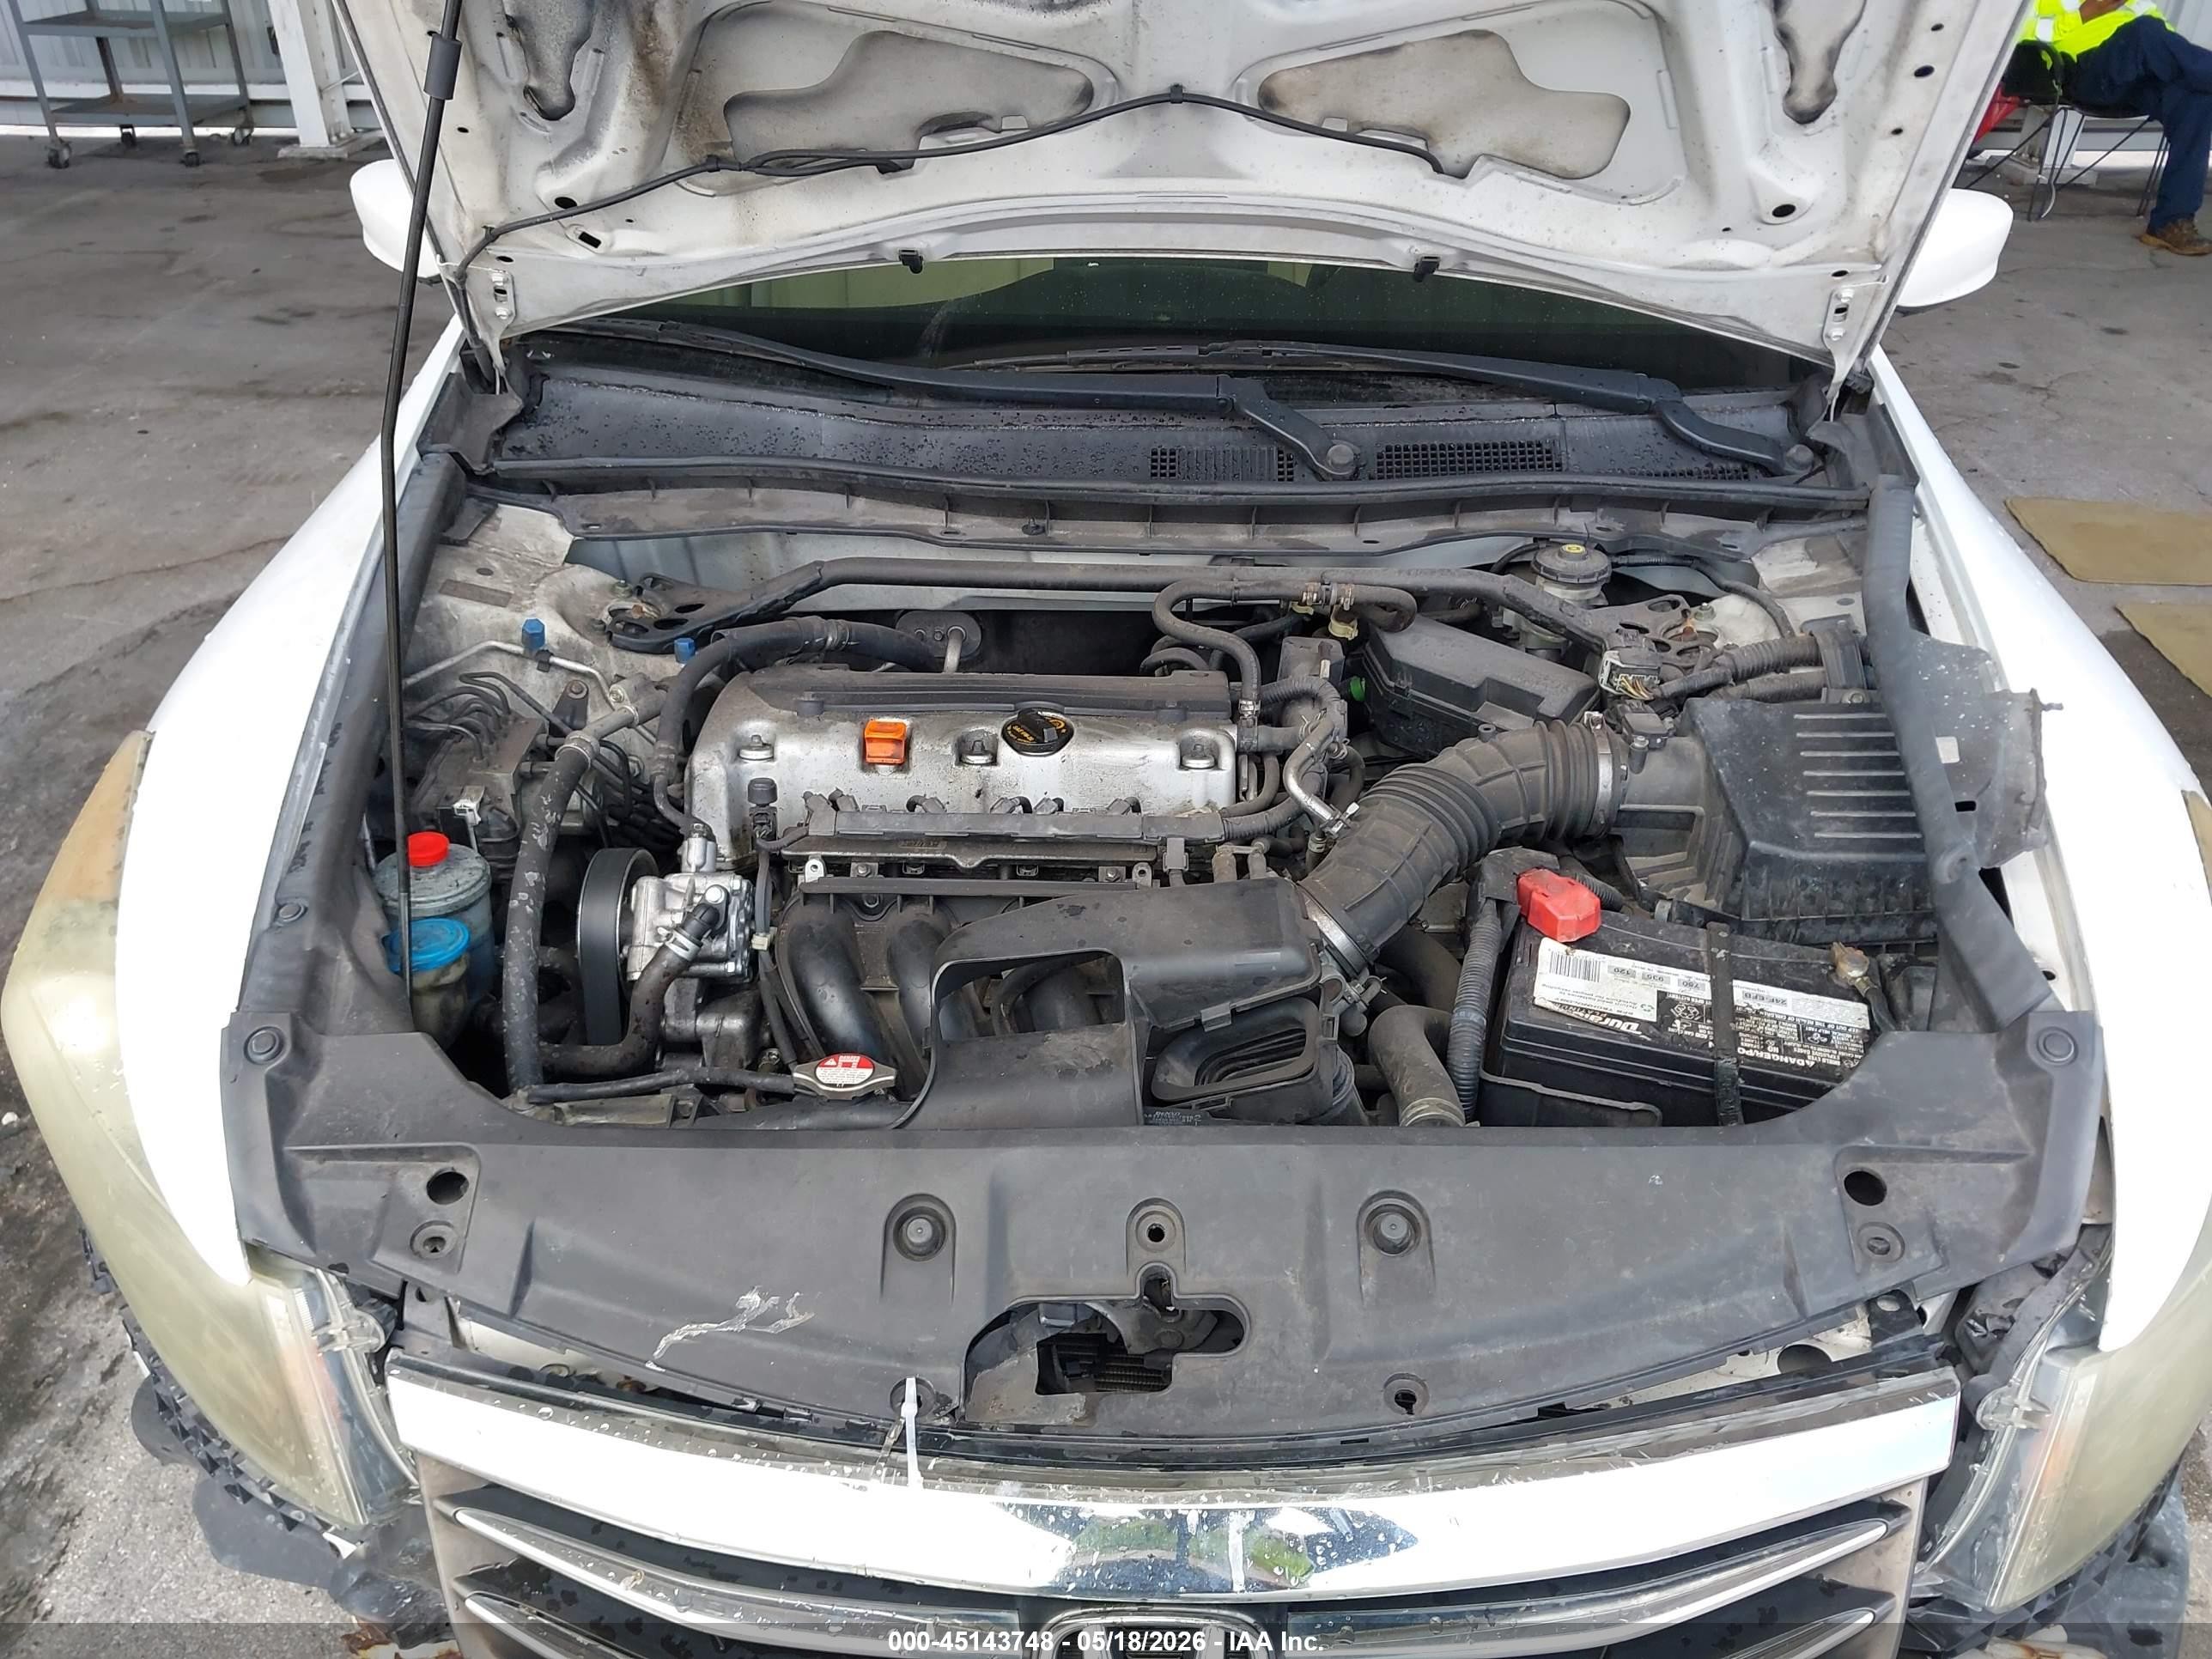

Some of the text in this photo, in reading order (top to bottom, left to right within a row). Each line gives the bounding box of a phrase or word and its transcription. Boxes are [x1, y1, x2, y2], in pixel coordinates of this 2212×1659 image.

[1613, 966, 1631, 975] 120
[1767, 1044, 1778, 1054] NO
[1811, 1049, 1839, 1060] EXPLOSIVE
